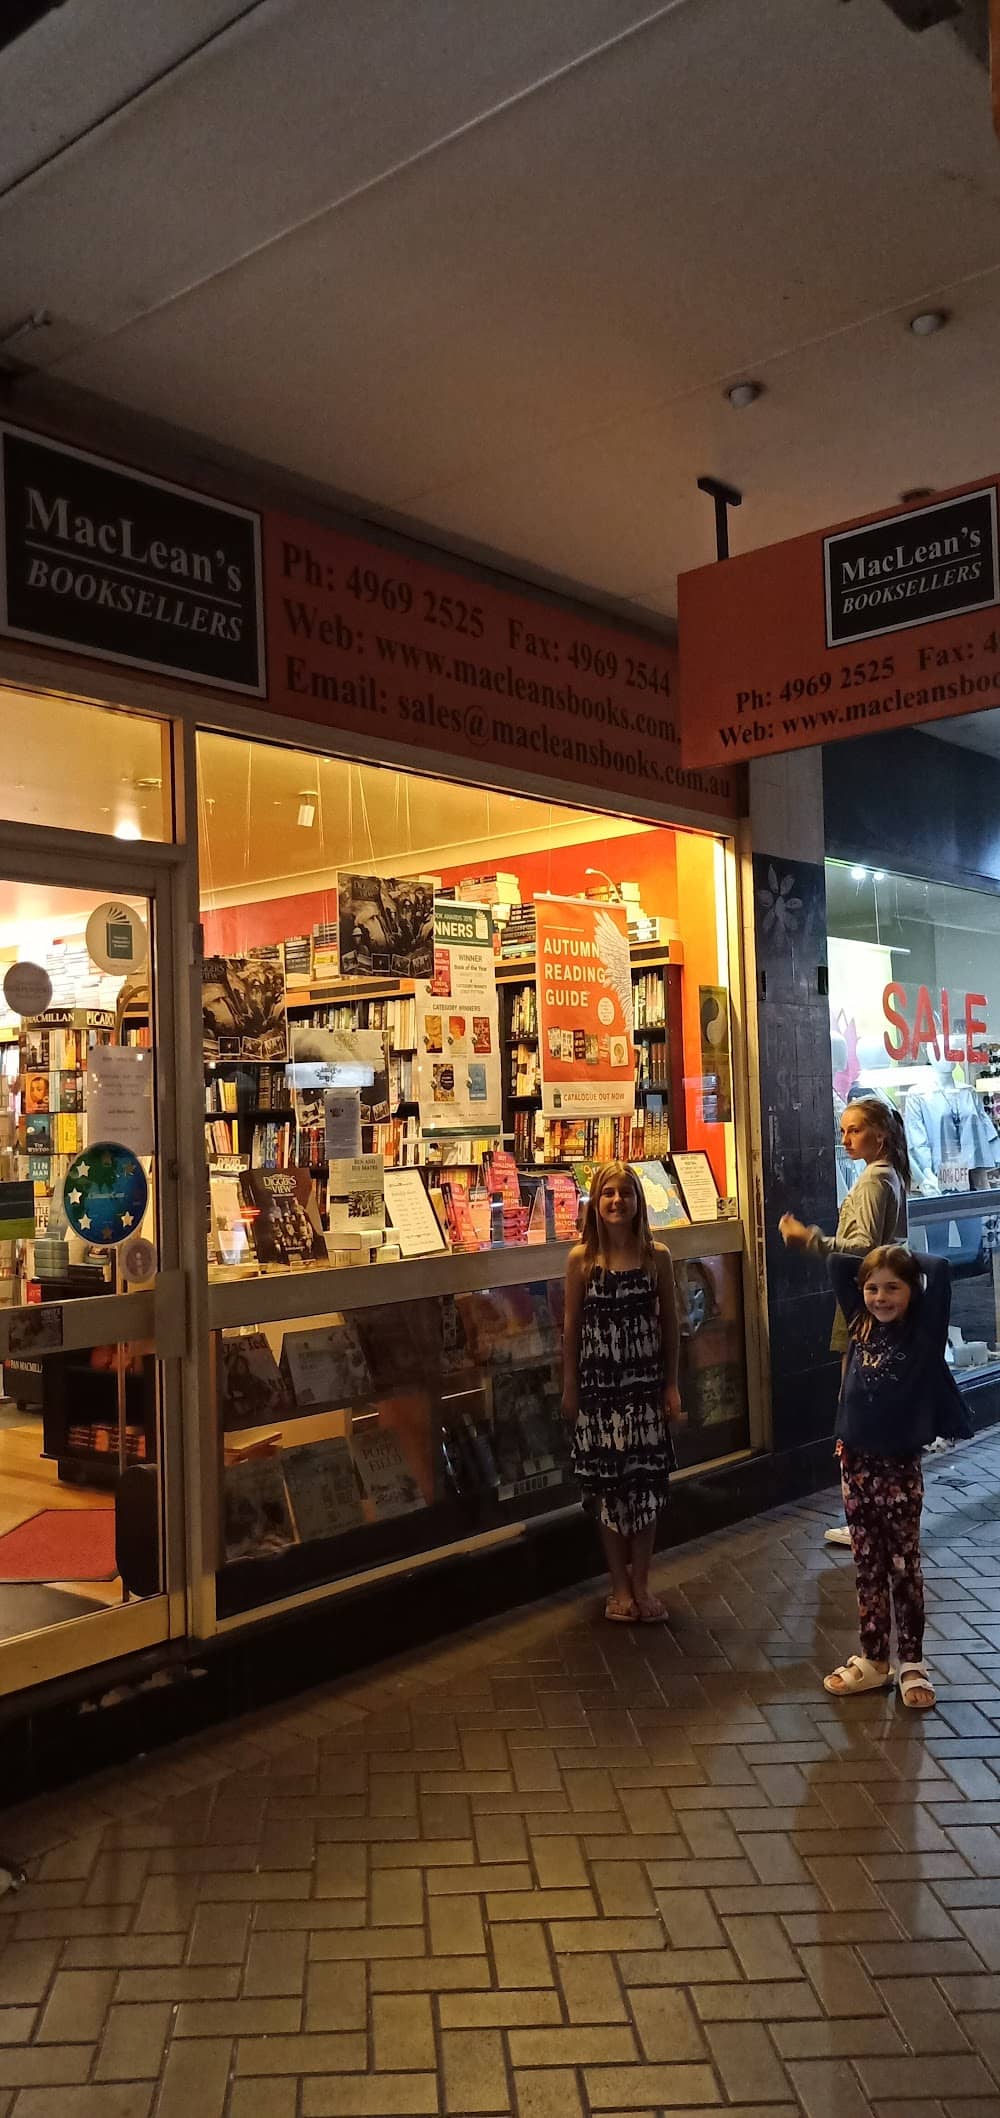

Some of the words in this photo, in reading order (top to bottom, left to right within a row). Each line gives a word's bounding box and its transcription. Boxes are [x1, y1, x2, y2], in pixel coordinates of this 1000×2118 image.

[25, 487, 244, 593] MacLean's
[841, 526, 982, 585] MacLean's
[27, 558, 243, 642] BOOKSELLERS
[842, 561, 983, 615] BOOKSELLERS
[281, 540, 335, 591] Ph:
[346, 565, 413, 614] 4969
[423, 589, 486, 639] 2525
[508, 616, 561, 664] Fax:
[567, 639, 619, 681] 4969
[625, 656, 672, 699] 2544
[282, 598, 365, 655] Web:
[285, 655, 388, 715] Email:
[736, 690, 772, 714] Ph:
[779, 671, 832, 703] 4969
[840, 656, 895, 690] 2525
[918, 641, 974, 672] Fax:
[719, 721, 774, 748] Web:
[543, 938, 600, 958] AUTUMN
[544, 963, 606, 983] READING
[545, 988, 589, 1008] GUIDE
[882, 981, 989, 1064] SALE
[563, 1093, 598, 1102] CATALOGUE
[598, 1093, 610, 1101] OUT
[33, 1162, 48, 1170] TIN
[271, 1185, 292, 1194] VIEW
[955, 1167, 969, 1182] OFF
